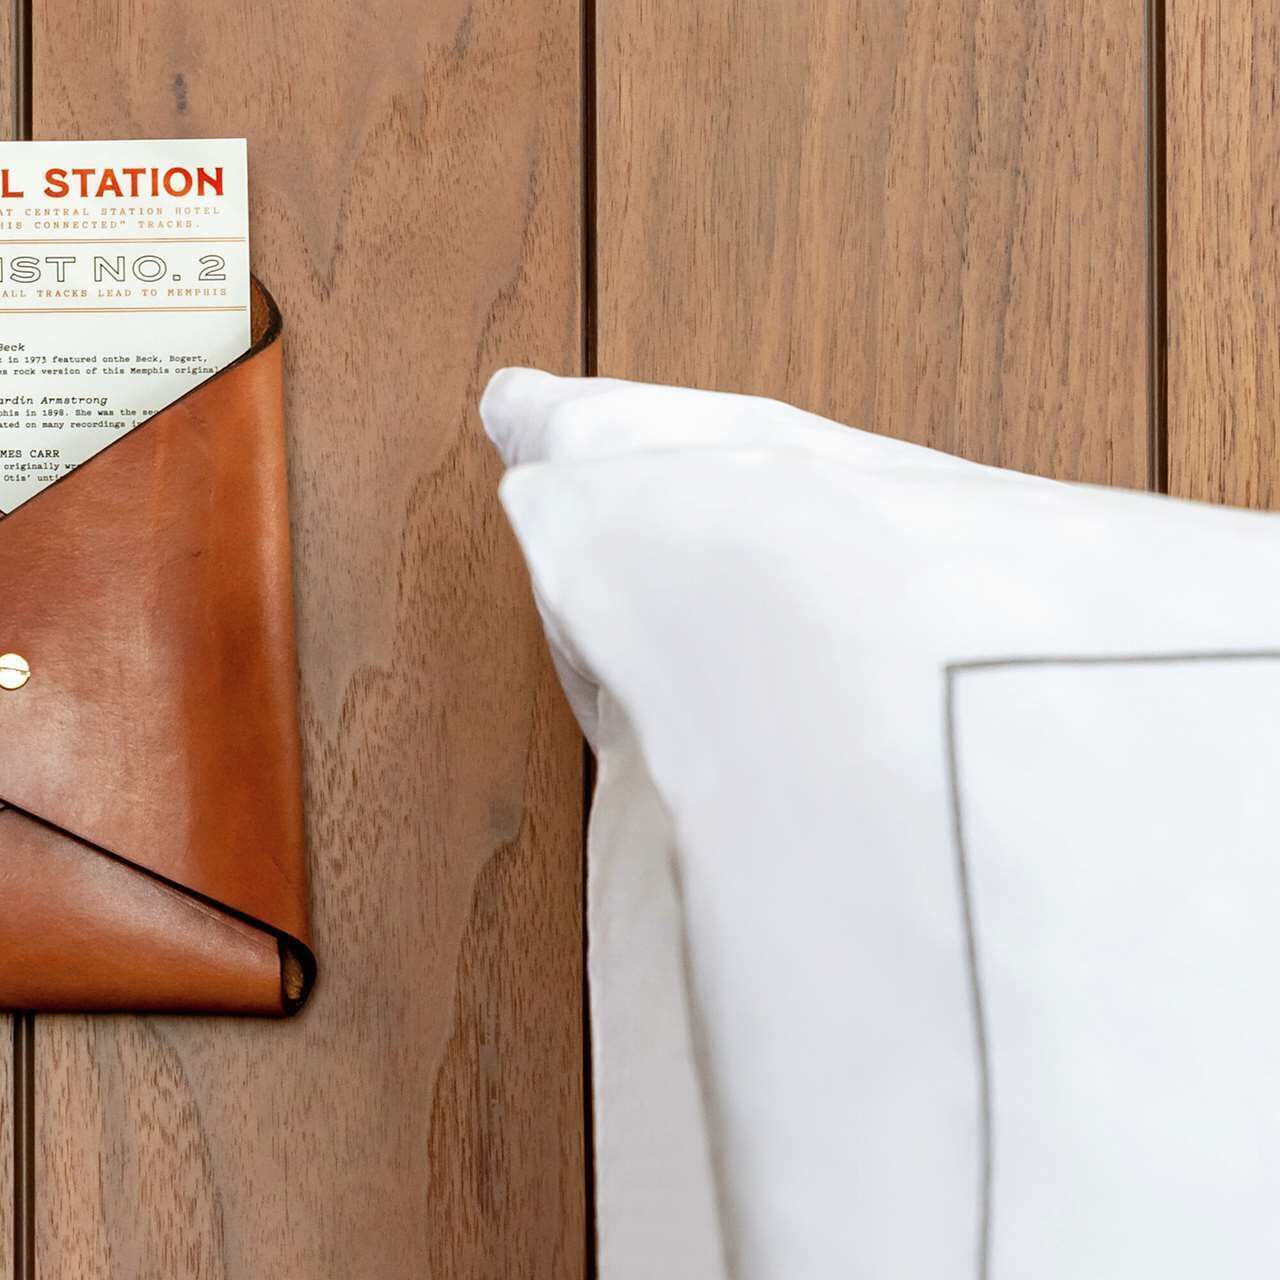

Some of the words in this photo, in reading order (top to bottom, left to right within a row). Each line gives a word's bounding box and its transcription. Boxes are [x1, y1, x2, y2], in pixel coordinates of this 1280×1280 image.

[44, 167, 224, 198] STATION
[25, 207, 88, 217] CENTRAL
[101, 207, 162, 216] STATION
[175, 206, 220, 216] HOTEL
[34, 219, 125, 230] CONNECTED”
[138, 219, 199, 229] TRACKS.
[94, 255, 181, 282] NO.
[198, 255, 226, 281] 2
[2, 289, 26, 299] ALL
[37, 289, 87, 298] TRACKS
[98, 288, 131, 298] LEAD
[141, 288, 157, 297] TO
[168, 287, 226, 297] MEMPHIS
[9, 355, 19, 364] in
[25, 355, 46, 365] 1973
[53, 355, 96, 364] featured
[136, 354, 162, 364] Beck,
[170, 355, 207, 365] Bogert,
[14, 367, 35, 376] rock
[42, 367, 80, 376] version
[86, 366, 97, 375] of
[103, 366, 124, 375] this
[130, 366, 169, 376] Memphis
[40, 396, 108, 407] Armstrong
[26, 408, 36, 417] in
[43, 408, 68, 417] 1898.
[75, 408, 92, 417] She
[98, 409, 114, 417] was
[120, 408, 136, 417] the
[42, 422, 64, 430] many
[70, 420, 126, 431] recordings
[30, 449, 59, 459] CARR
[4, 462, 60, 472] originally
